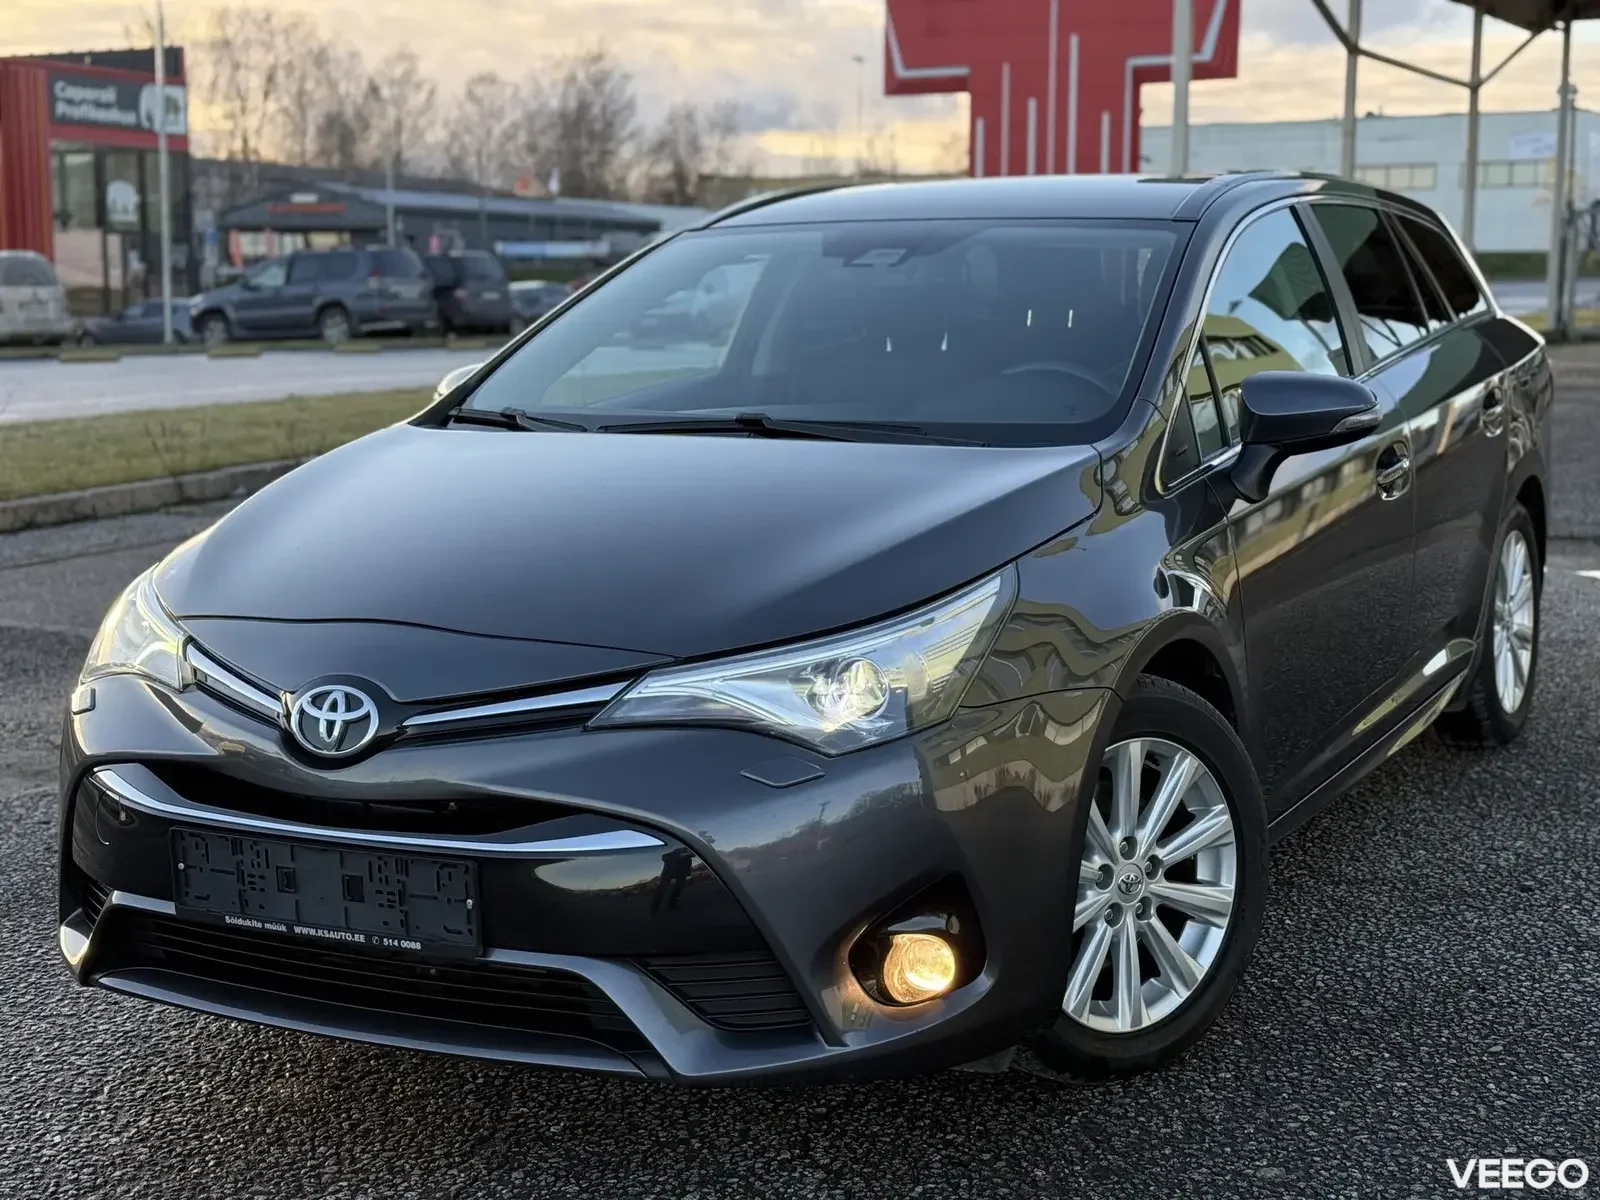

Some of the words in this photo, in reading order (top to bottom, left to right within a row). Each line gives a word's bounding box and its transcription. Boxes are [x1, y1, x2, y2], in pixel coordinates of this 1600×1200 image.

[264, 922, 288, 932] müük
[293, 925, 366, 943] WWW.KSAUTO.EE
[383, 937, 399, 948] 514
[400, 940, 422, 950] 0088
